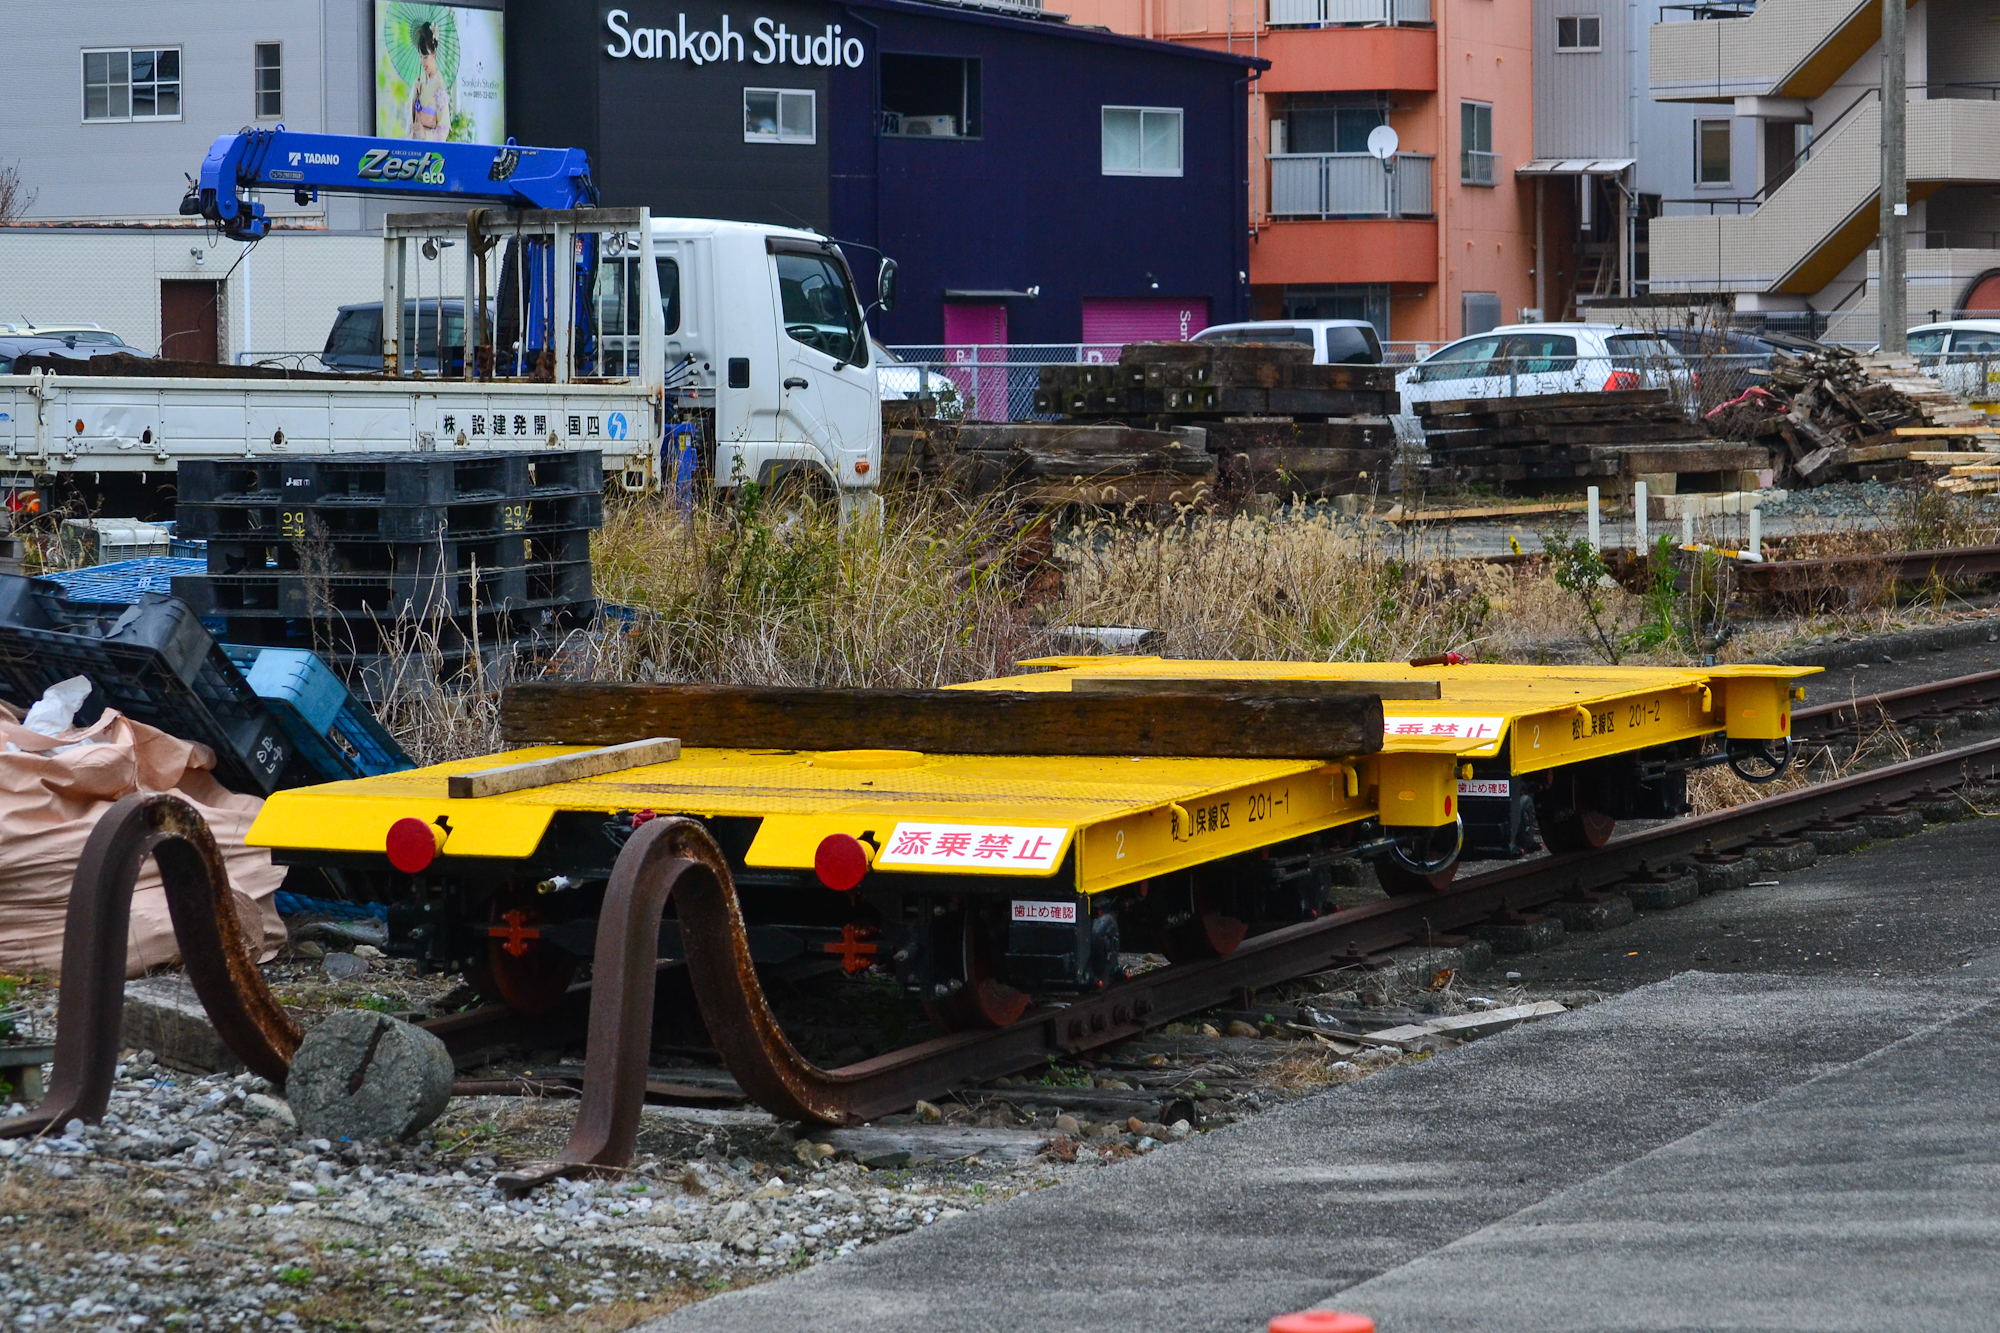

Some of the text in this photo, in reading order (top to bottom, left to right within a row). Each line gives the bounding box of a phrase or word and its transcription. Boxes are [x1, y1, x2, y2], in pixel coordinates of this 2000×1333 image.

[607, 9, 864, 68] Sankoh Studio
[303, 153, 340, 165] TADANO
[357, 149, 446, 185] Zest eco
[1629, 700, 1660, 728] 201-2
[1533, 724, 1541, 749] 2
[1457, 783, 1508, 795] 歯止め確認
[1248, 787, 1290, 823] 201-1
[890, 830, 1052, 861] 添乗禁止
[1115, 829, 1126, 860] 2
[1013, 904, 1074, 919] 歯止め確認
